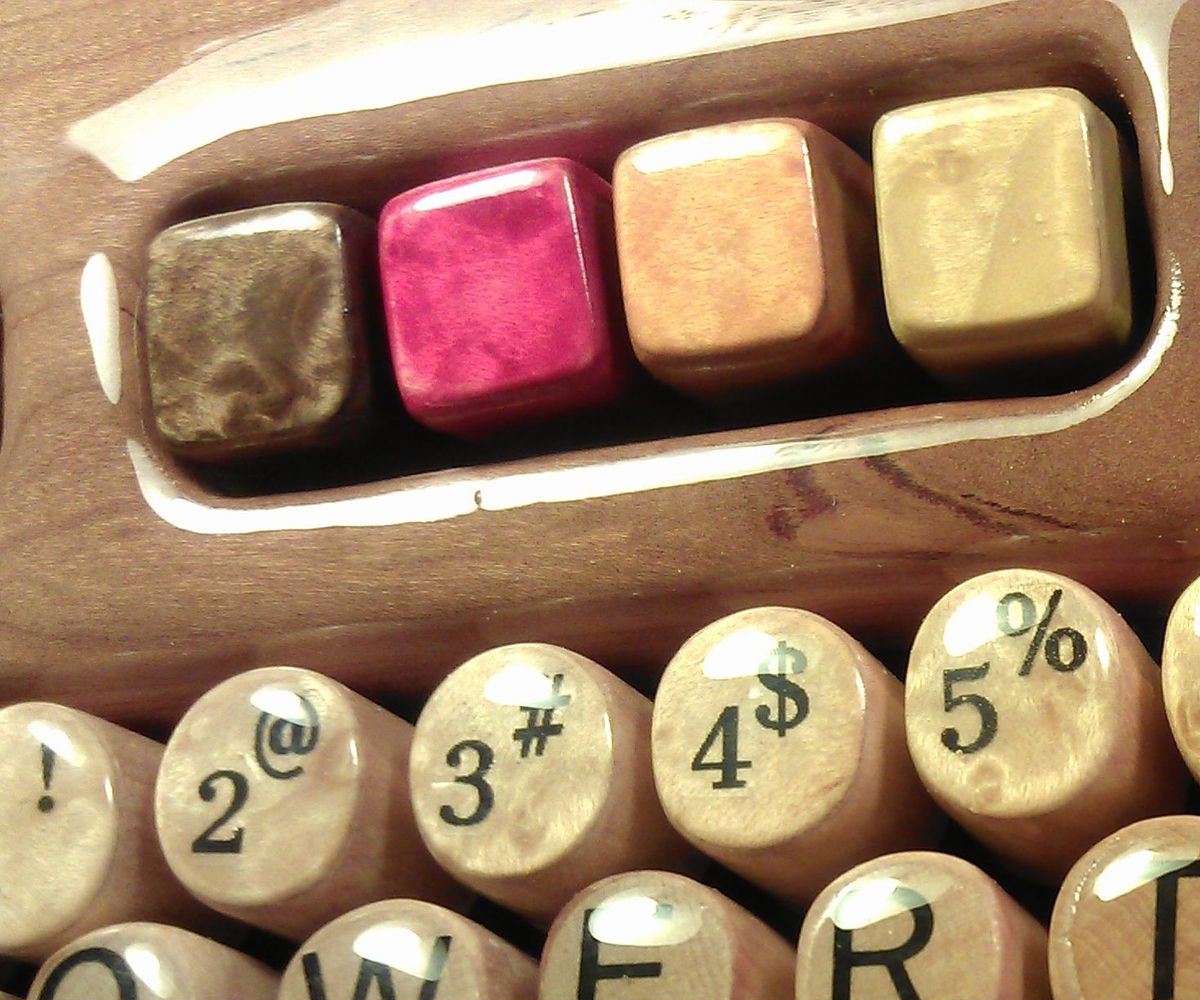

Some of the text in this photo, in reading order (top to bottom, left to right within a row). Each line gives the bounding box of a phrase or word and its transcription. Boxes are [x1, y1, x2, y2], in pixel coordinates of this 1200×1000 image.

[997, 589, 1088, 677] %
[513, 674, 571, 758] #
[755, 640, 810, 738] $
[941, 662, 998, 755] 5
[37, 738, 57, 814] !
[253, 693, 320, 780] @
[691, 705, 752, 790] 4
[192, 770, 250, 854] 2
[439, 740, 494, 826] 3
